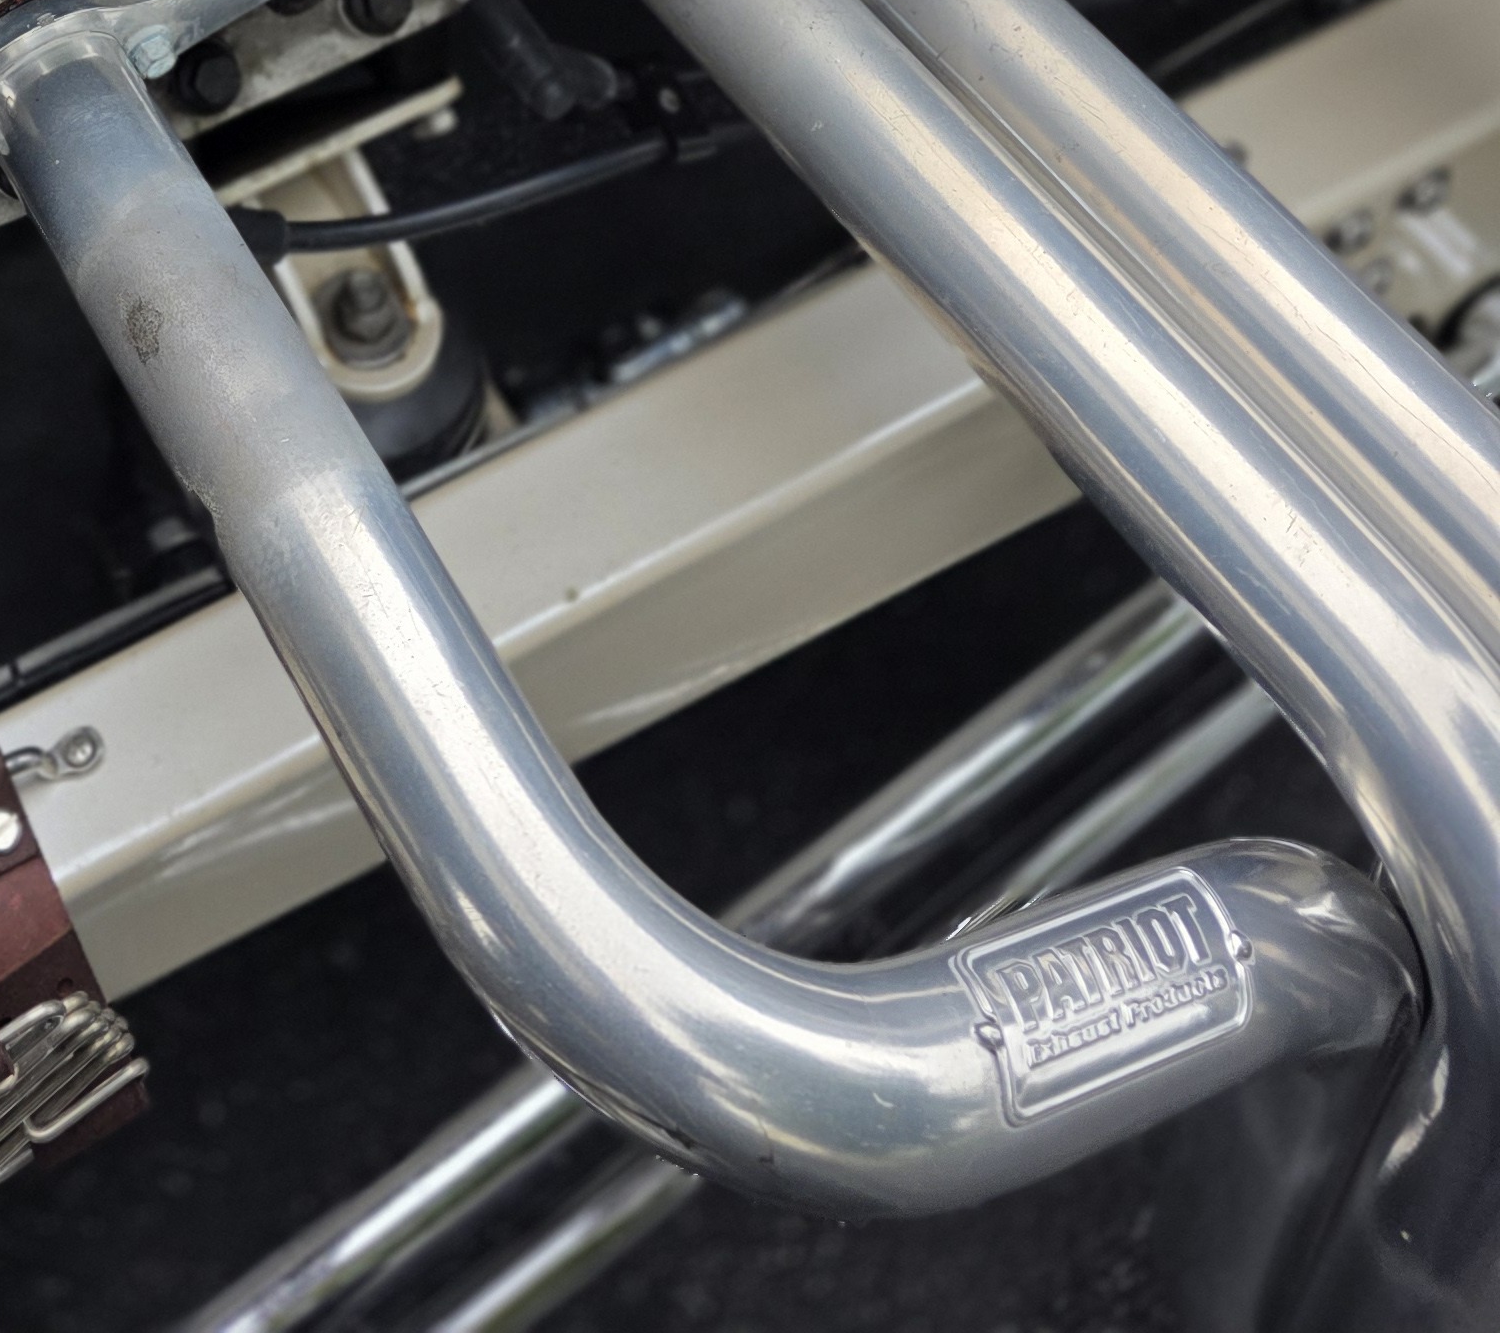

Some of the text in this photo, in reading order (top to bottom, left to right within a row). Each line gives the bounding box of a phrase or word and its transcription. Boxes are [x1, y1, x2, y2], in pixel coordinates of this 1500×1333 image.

[995, 893, 1212, 1033] PATRIOT
[1026, 966, 1228, 1069] Exhaust Products
